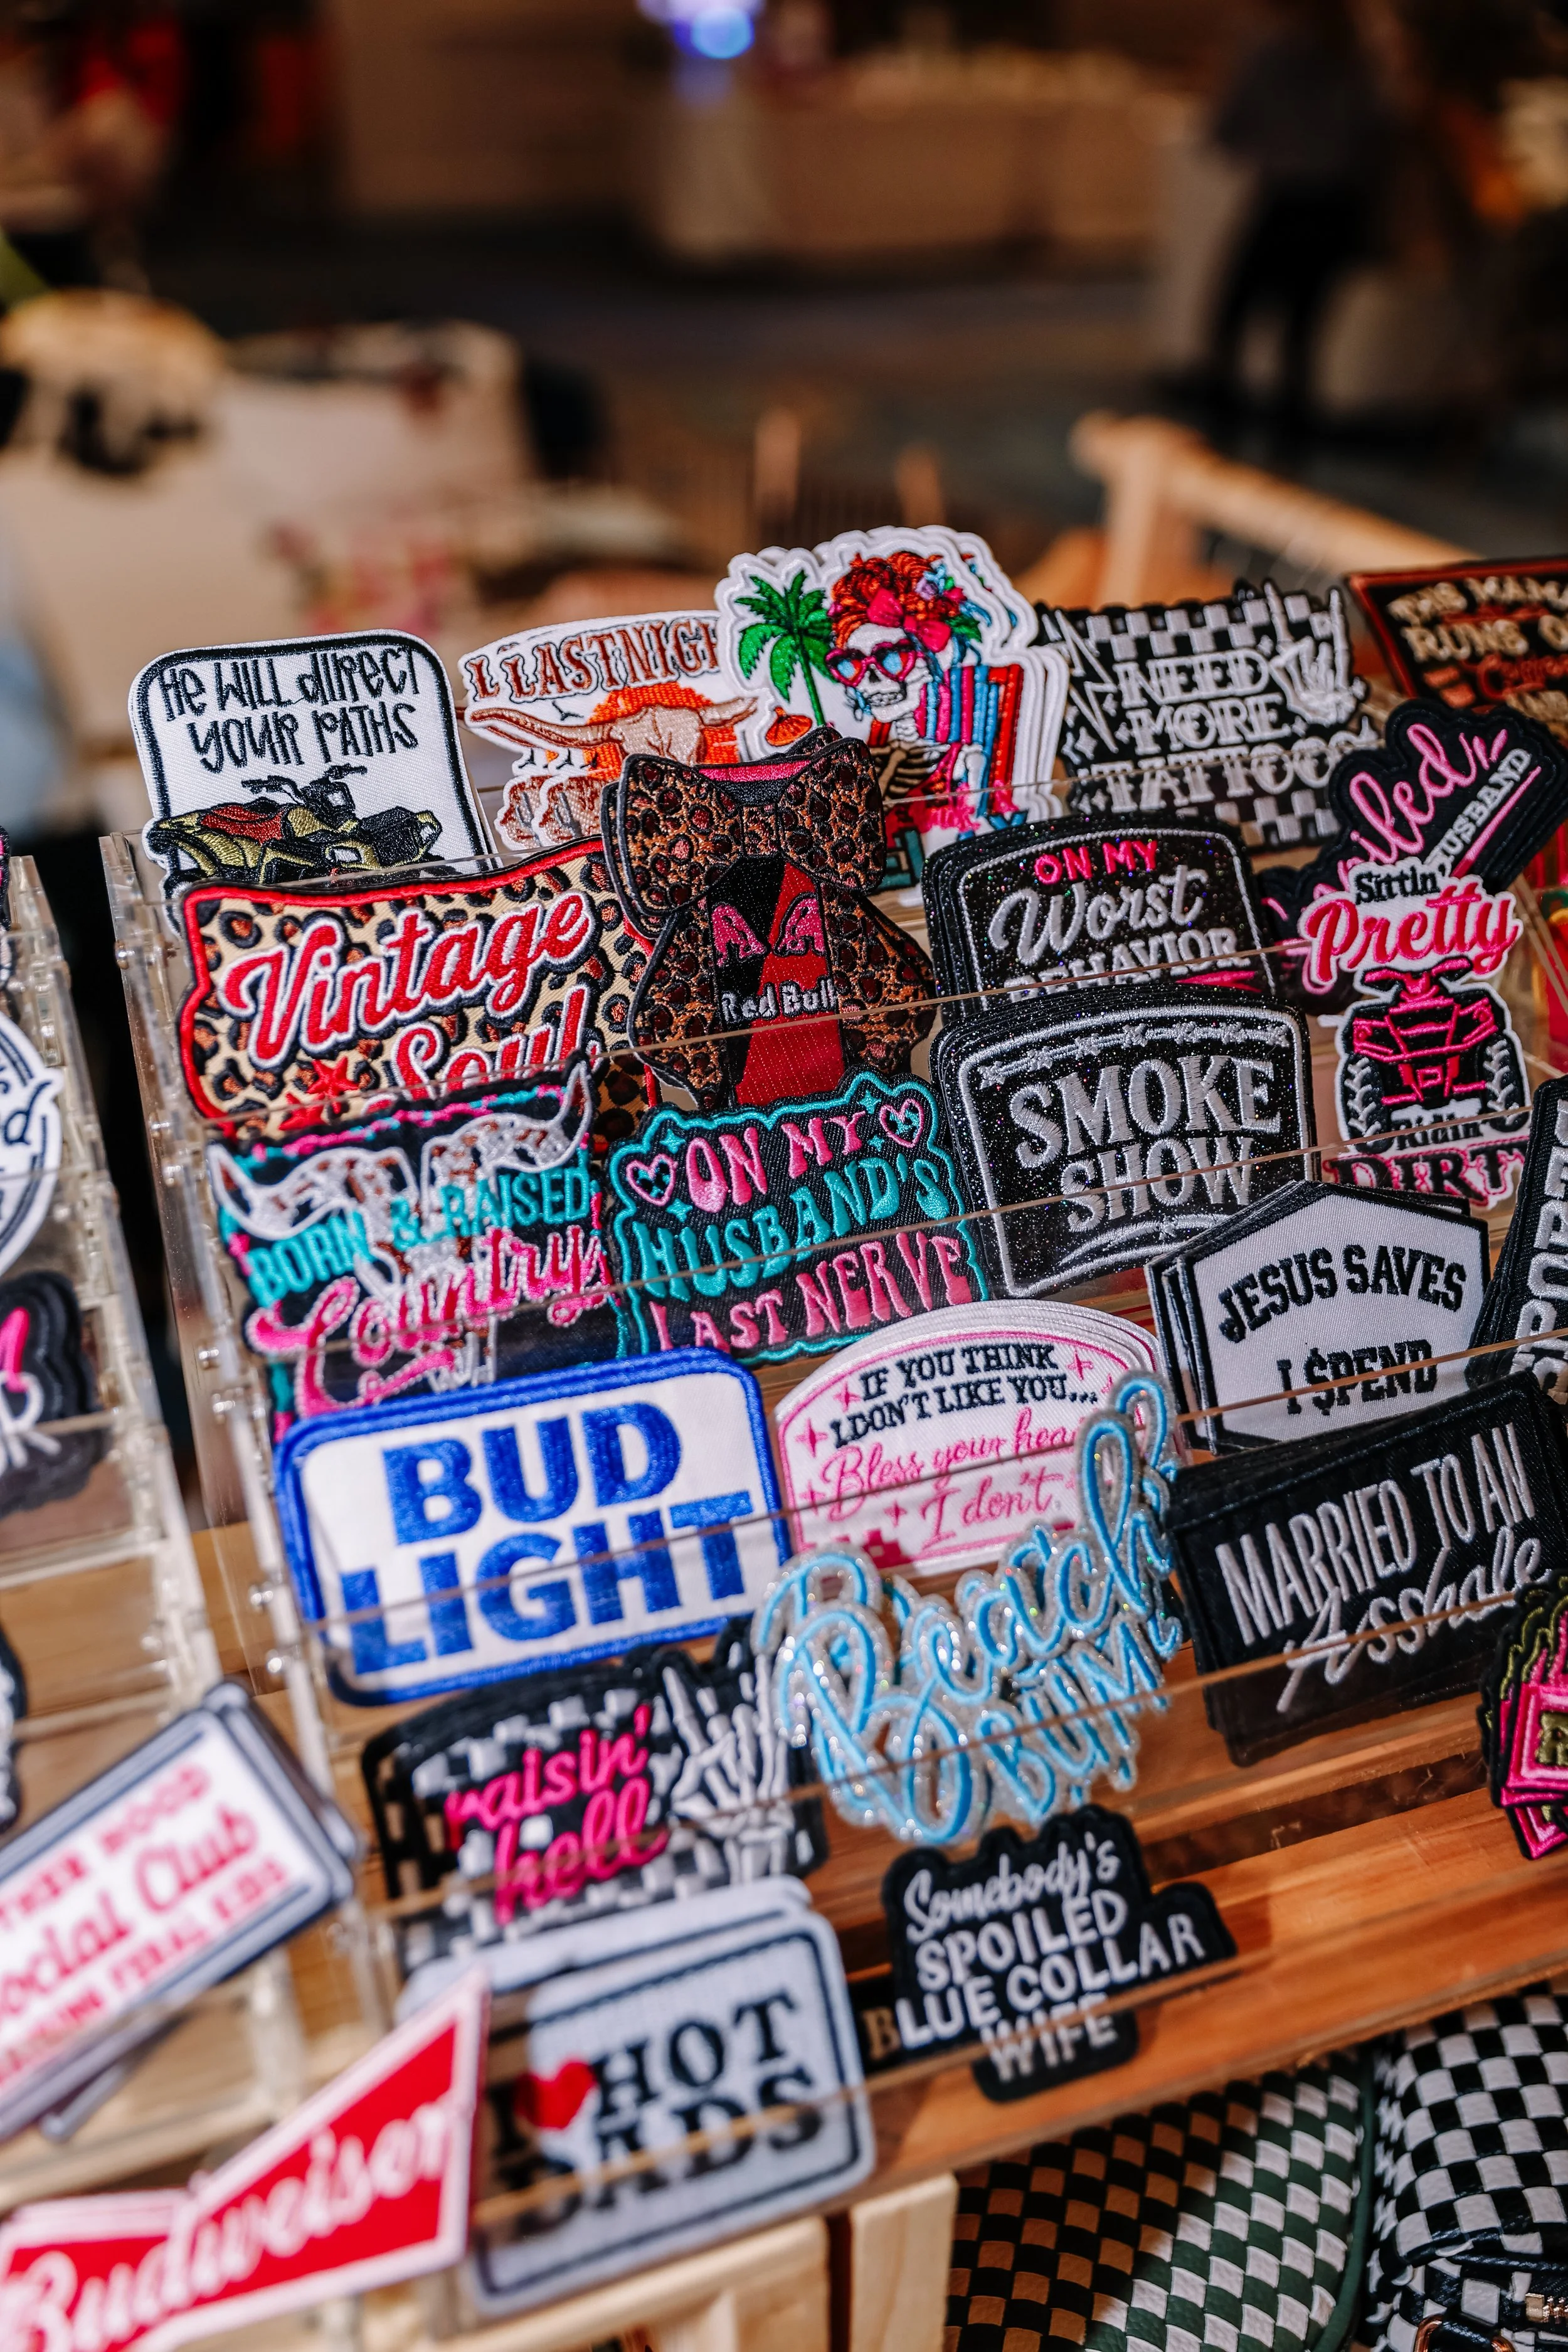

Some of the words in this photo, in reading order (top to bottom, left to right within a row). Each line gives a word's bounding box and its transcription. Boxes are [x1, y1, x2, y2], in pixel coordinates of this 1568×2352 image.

[213, 659, 294, 711] WILL
[1113, 648, 1269, 709] NEED
[1126, 692, 1291, 755] MORE
[312, 701, 419, 763] PATHS
[988, 864, 1209, 967] Worst
[1034, 845, 1093, 886] ON
[1103, 839, 1158, 875] MY
[218, 891, 596, 1066] Vintage
[1305, 881, 1520, 983] Pretty
[721, 982, 778, 1023] Red
[781, 977, 838, 1017] Bull
[686, 1126, 768, 1214] ON
[781, 1110, 866, 1179] MY
[1009, 1055, 1281, 1169] SMOKE
[1061, 1135, 1254, 1233] SHOW
[1336, 1138, 1529, 1203] DIRT
[248, 1207, 376, 1308] BORN
[390, 1197, 422, 1253] &
[438, 1165, 591, 1241] RAISED
[631, 1152, 951, 1303] HUSBAND'S
[246, 1224, 613, 1419] Country
[795, 1230, 974, 1338] NERVE
[1217, 1246, 1338, 1344] JESUS
[1343, 1244, 1467, 1313] SAVES
[849, 1392, 934, 1442] DON'T
[936, 1378, 1005, 1411] LIKE
[1007, 1374, 1098, 1405] YOU...
[858, 1367, 891, 1402] IF
[896, 1347, 956, 1389] YOU
[960, 1343, 1059, 1374] THINK
[1276, 1358, 1302, 1416] I
[381, 1401, 682, 1545] BUD
[820, 1441, 925, 1524] Bless
[933, 1434, 1006, 1488] your
[1013, 1406, 1077, 1465] hea
[919, 1486, 961, 1552] I
[1214, 1478, 1417, 1647] MARRIED
[1410, 1454, 1476, 1550] TO
[1470, 1422, 1536, 1534] AN
[341, 1489, 755, 1675] LIGHT
[778, 1415, 1173, 1846] Beach
[443, 1702, 651, 1851] raisin'
[494, 1776, 669, 1927] hell
[903, 1830, 1121, 1944] Somebody's
[0, 1890, 134, 2016] ocial
[134, 1801, 260, 1916] Club
[915, 1888, 1129, 1992] SPOILED
[862, 1974, 1002, 2060] BLUE
[1005, 1912, 1207, 2012] COLLAR
[980, 1991, 1119, 2082] WIFE
[590, 1987, 797, 2121] HOT
[0, 2100, 449, 2352] Budweiser
